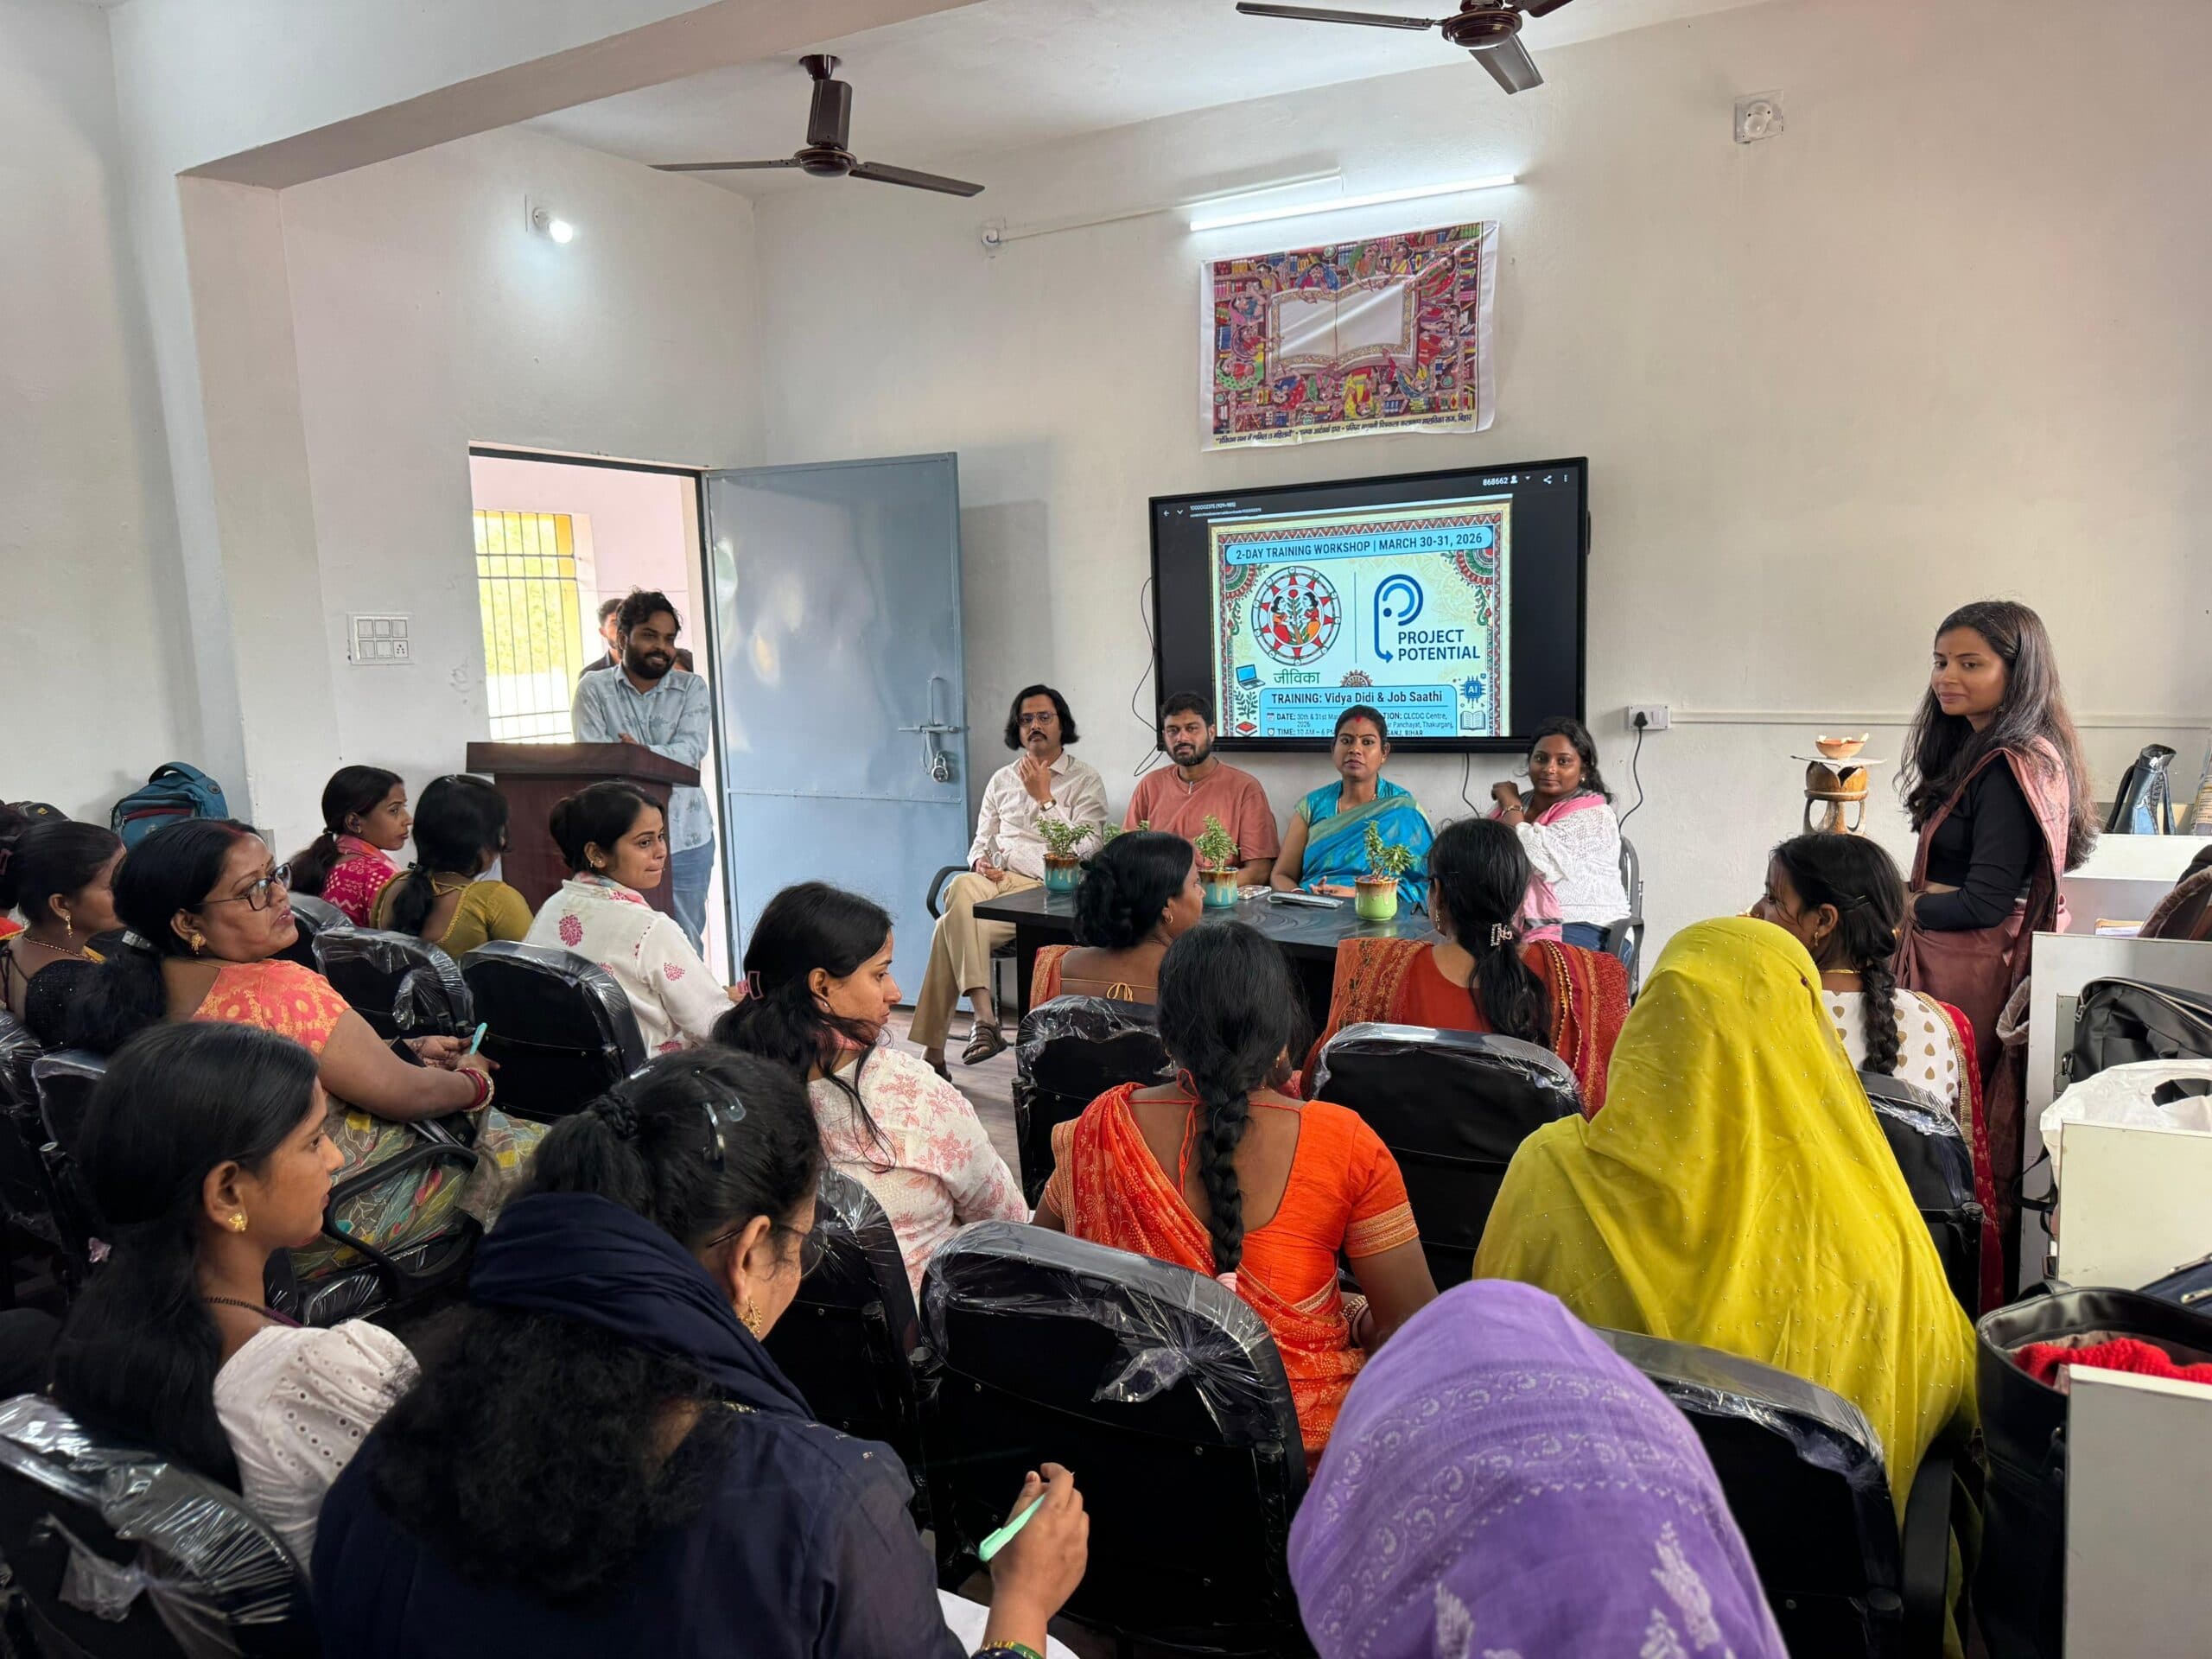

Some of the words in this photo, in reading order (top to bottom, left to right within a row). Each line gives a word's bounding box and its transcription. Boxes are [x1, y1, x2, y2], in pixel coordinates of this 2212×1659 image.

[1236, 548, 1264, 560] 2-DAY
[1266, 545, 1312, 558] TRAINING
[1313, 541, 1370, 555] WORKSHOP
[1379, 537, 1417, 550] MARCH
[1420, 536, 1453, 547] 30-31,
[1456, 533, 1482, 544] 2026
[1398, 629, 1465, 645] PROJECT
[1398, 645, 1480, 661] POTENTIAL
[1273, 669, 1320, 684] जीविका
[1469, 685, 1478, 694] AI
[1272, 693, 1322, 704] TRAINING:
[1325, 692, 1351, 706] Vidya
[1355, 692, 1375, 703] Didi
[1377, 692, 1383, 702] &
[1388, 691, 1407, 702] Job
[1409, 691, 1442, 702] Saathi
